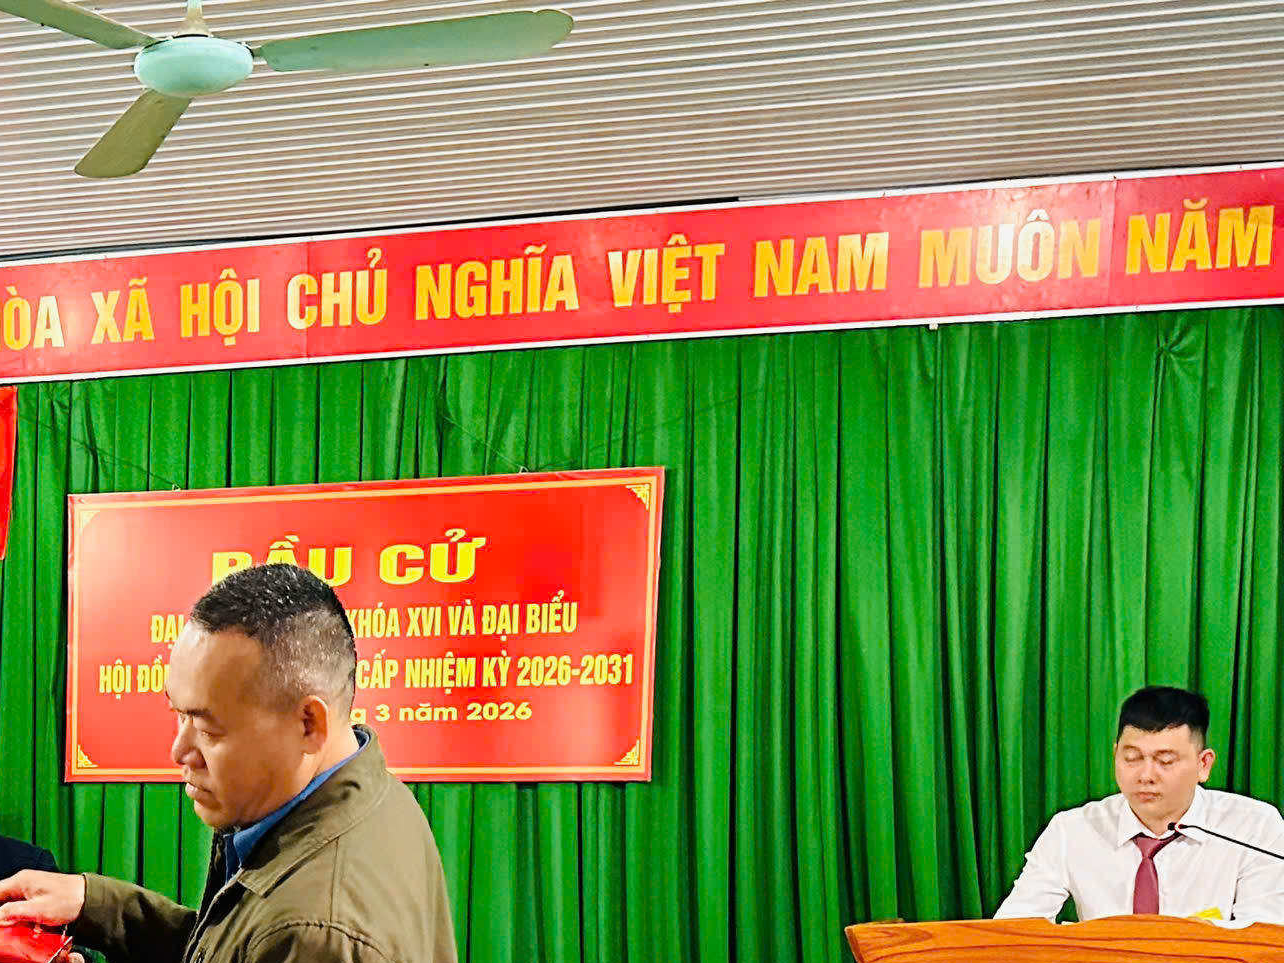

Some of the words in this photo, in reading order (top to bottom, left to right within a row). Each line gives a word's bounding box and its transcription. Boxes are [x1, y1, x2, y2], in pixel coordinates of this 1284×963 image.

[91, 276, 156, 345] XÃ
[179, 268, 260, 347] HỘI
[286, 248, 388, 330] CHỦ
[415, 245, 580, 320] NGHĨA
[607, 234, 725, 314] VIỆT
[754, 231, 890, 297] NAM
[918, 209, 1102, 288] MUÔN
[1125, 198, 1276, 275] NĂM
[379, 528, 487, 585] CỬ
[406, 606, 442, 637] XVI
[447, 599, 476, 636] VÀ
[481, 603, 520, 642] ĐẠI
[525, 590, 578, 634] BIỂU
[99, 658, 132, 700] HỘI
[356, 649, 399, 690] CẤP
[404, 651, 477, 695] NHIỆM
[482, 649, 512, 688] KỲ
[516, 653, 633, 687] 2026-2031
[375, 703, 391, 722] 3
[398, 702, 458, 722] năm
[466, 702, 533, 721] 2026
